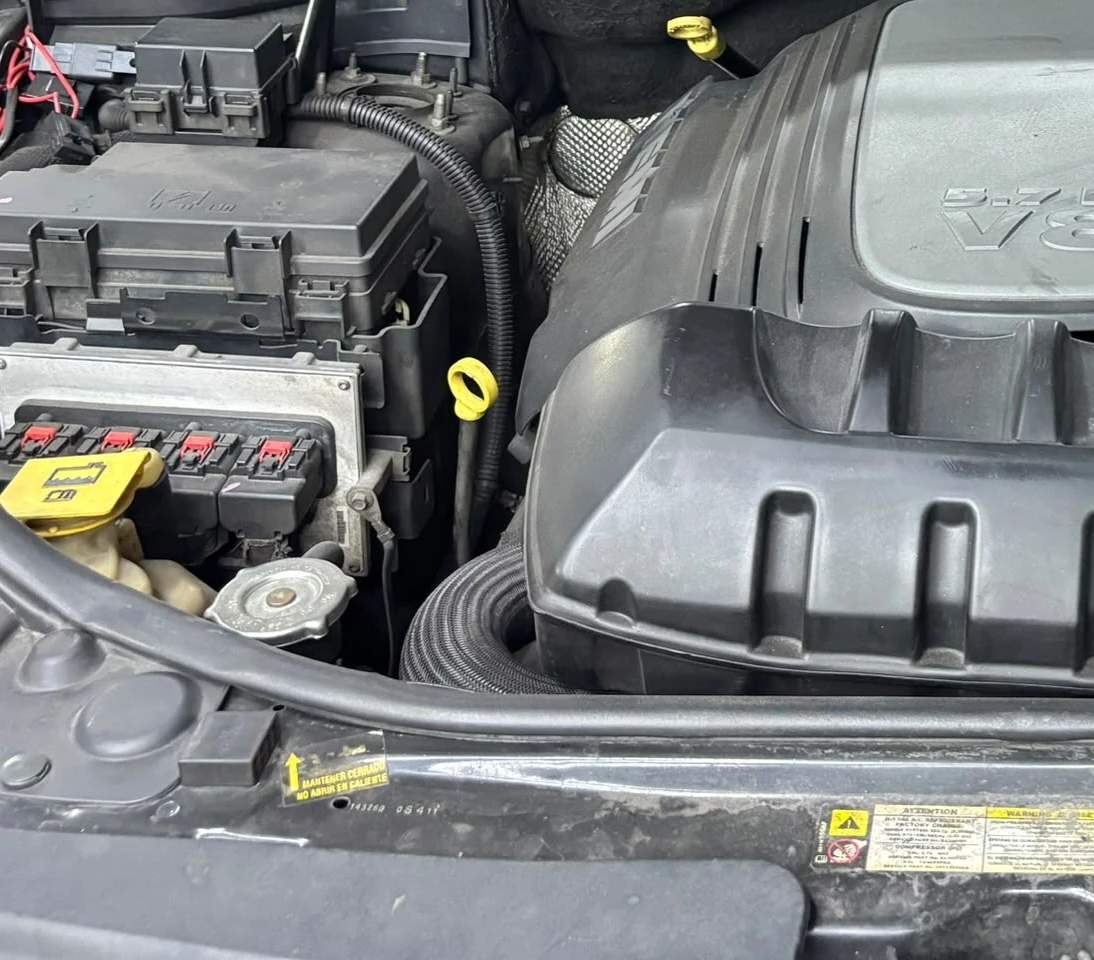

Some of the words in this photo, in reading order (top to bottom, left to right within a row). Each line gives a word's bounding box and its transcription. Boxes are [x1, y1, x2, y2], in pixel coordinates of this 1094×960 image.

[297, 790, 309, 800] NO
[310, 785, 336, 797] ABRIR
[337, 782, 348, 792] EN
[349, 773, 388, 789] CALIENTE
[302, 772, 346, 789] MANTENER
[347, 761, 385, 780] CERRADO
[1006, 809, 1052, 818] WARNING
